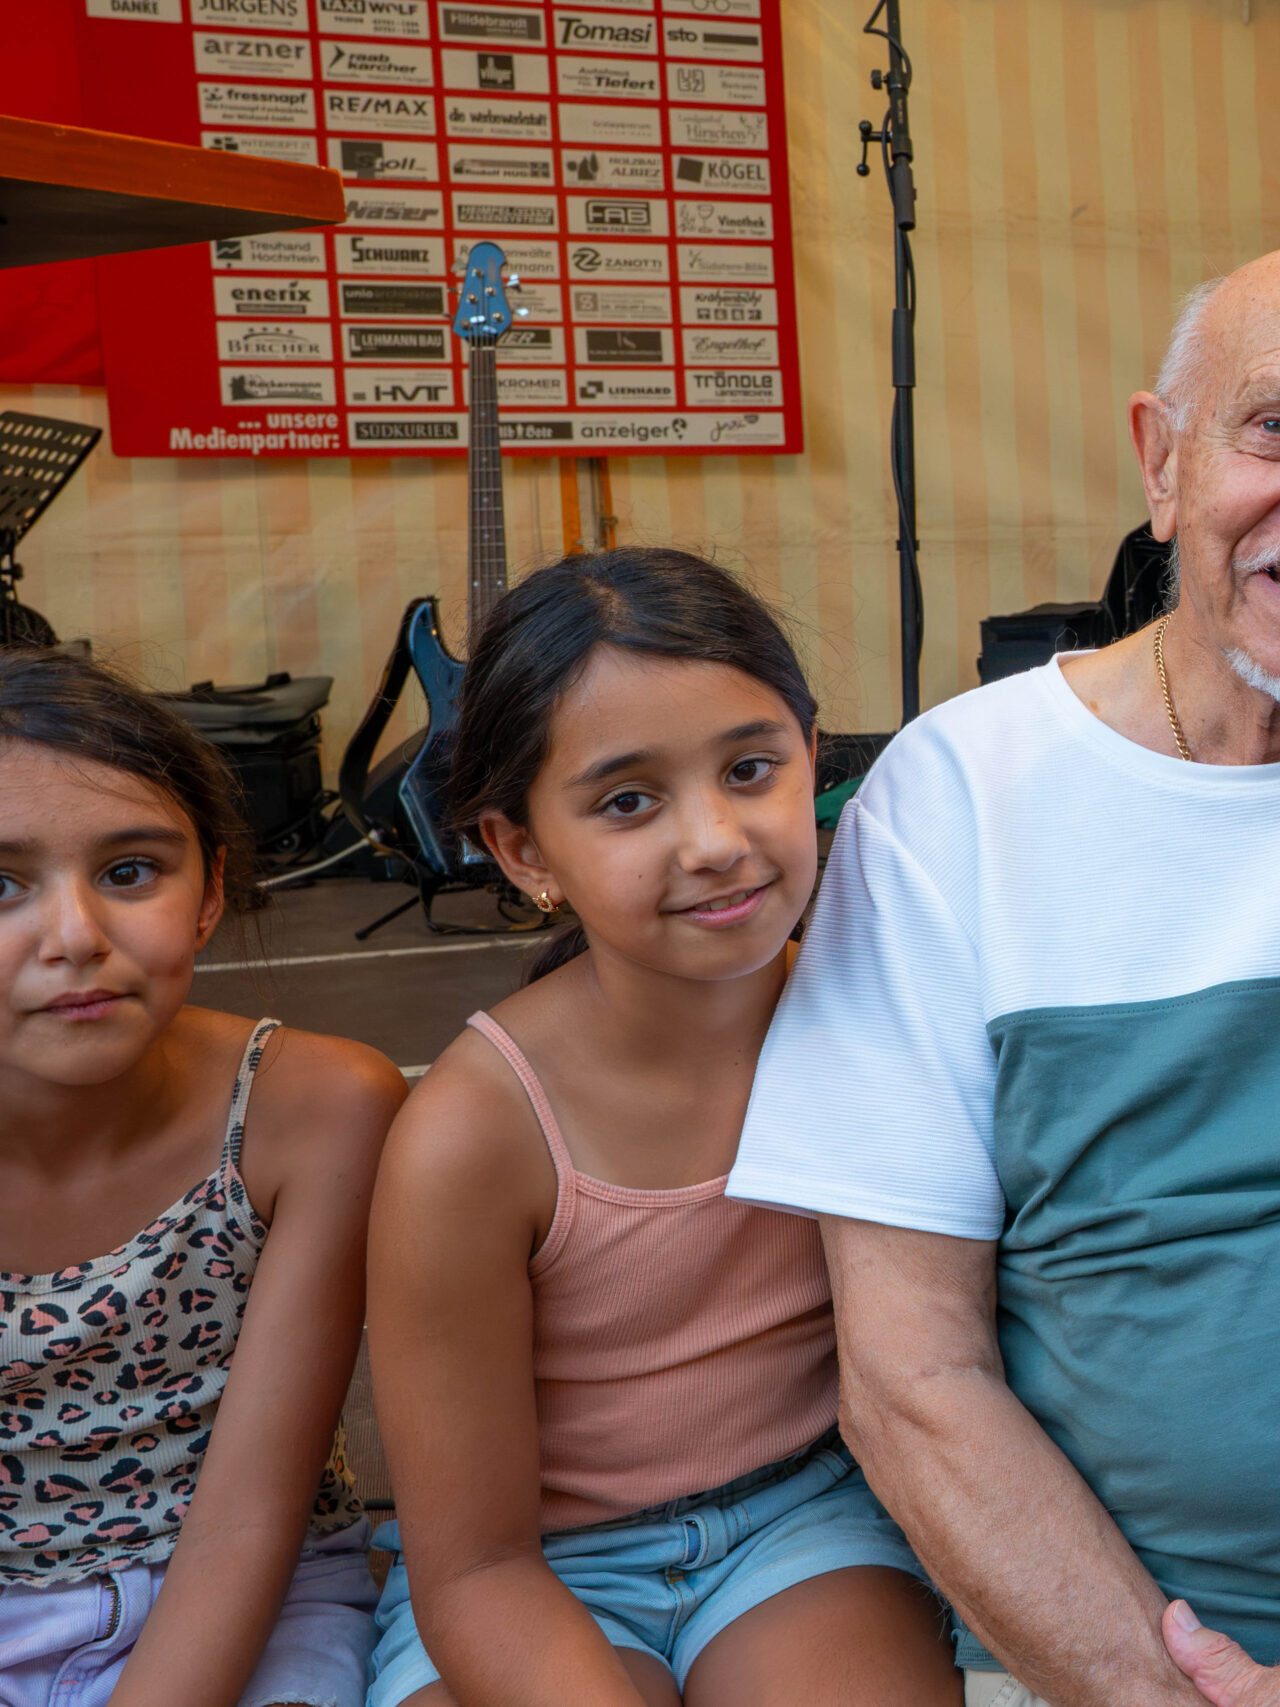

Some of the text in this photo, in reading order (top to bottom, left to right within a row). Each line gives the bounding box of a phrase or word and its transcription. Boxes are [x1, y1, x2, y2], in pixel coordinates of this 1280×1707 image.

[111, 0, 159, 15] DANKE
[450, 12, 527, 29] Hildebrandt
[558, 17, 653, 45] Tomasi
[667, 28, 698, 42] sto
[204, 39, 306, 60] arzner
[348, 53, 389, 63] raab
[347, 63, 417, 74] karcher
[594, 76, 655, 91] Tiefert
[227, 89, 307, 105] fressnapf
[329, 96, 428, 117] RE/MAX
[707, 159, 766, 181] KÖGEL
[717, 215, 765, 228] Vinothek
[249, 240, 311, 252] Treuhand
[251, 253, 320, 264] Hochrhein
[604, 258, 663, 268] ZANOTTI
[231, 281, 313, 302] enerix
[228, 339, 320, 354] BERCHER
[361, 333, 418, 348] LEHMANN
[419, 335, 442, 348] BAU
[608, 386, 672, 395] LIENHARD
[266, 413, 339, 430] unsere
[359, 423, 455, 438] SÜDKURIER
[581, 422, 671, 441] anzeiger
[170, 427, 340, 455] Medienpartner:
